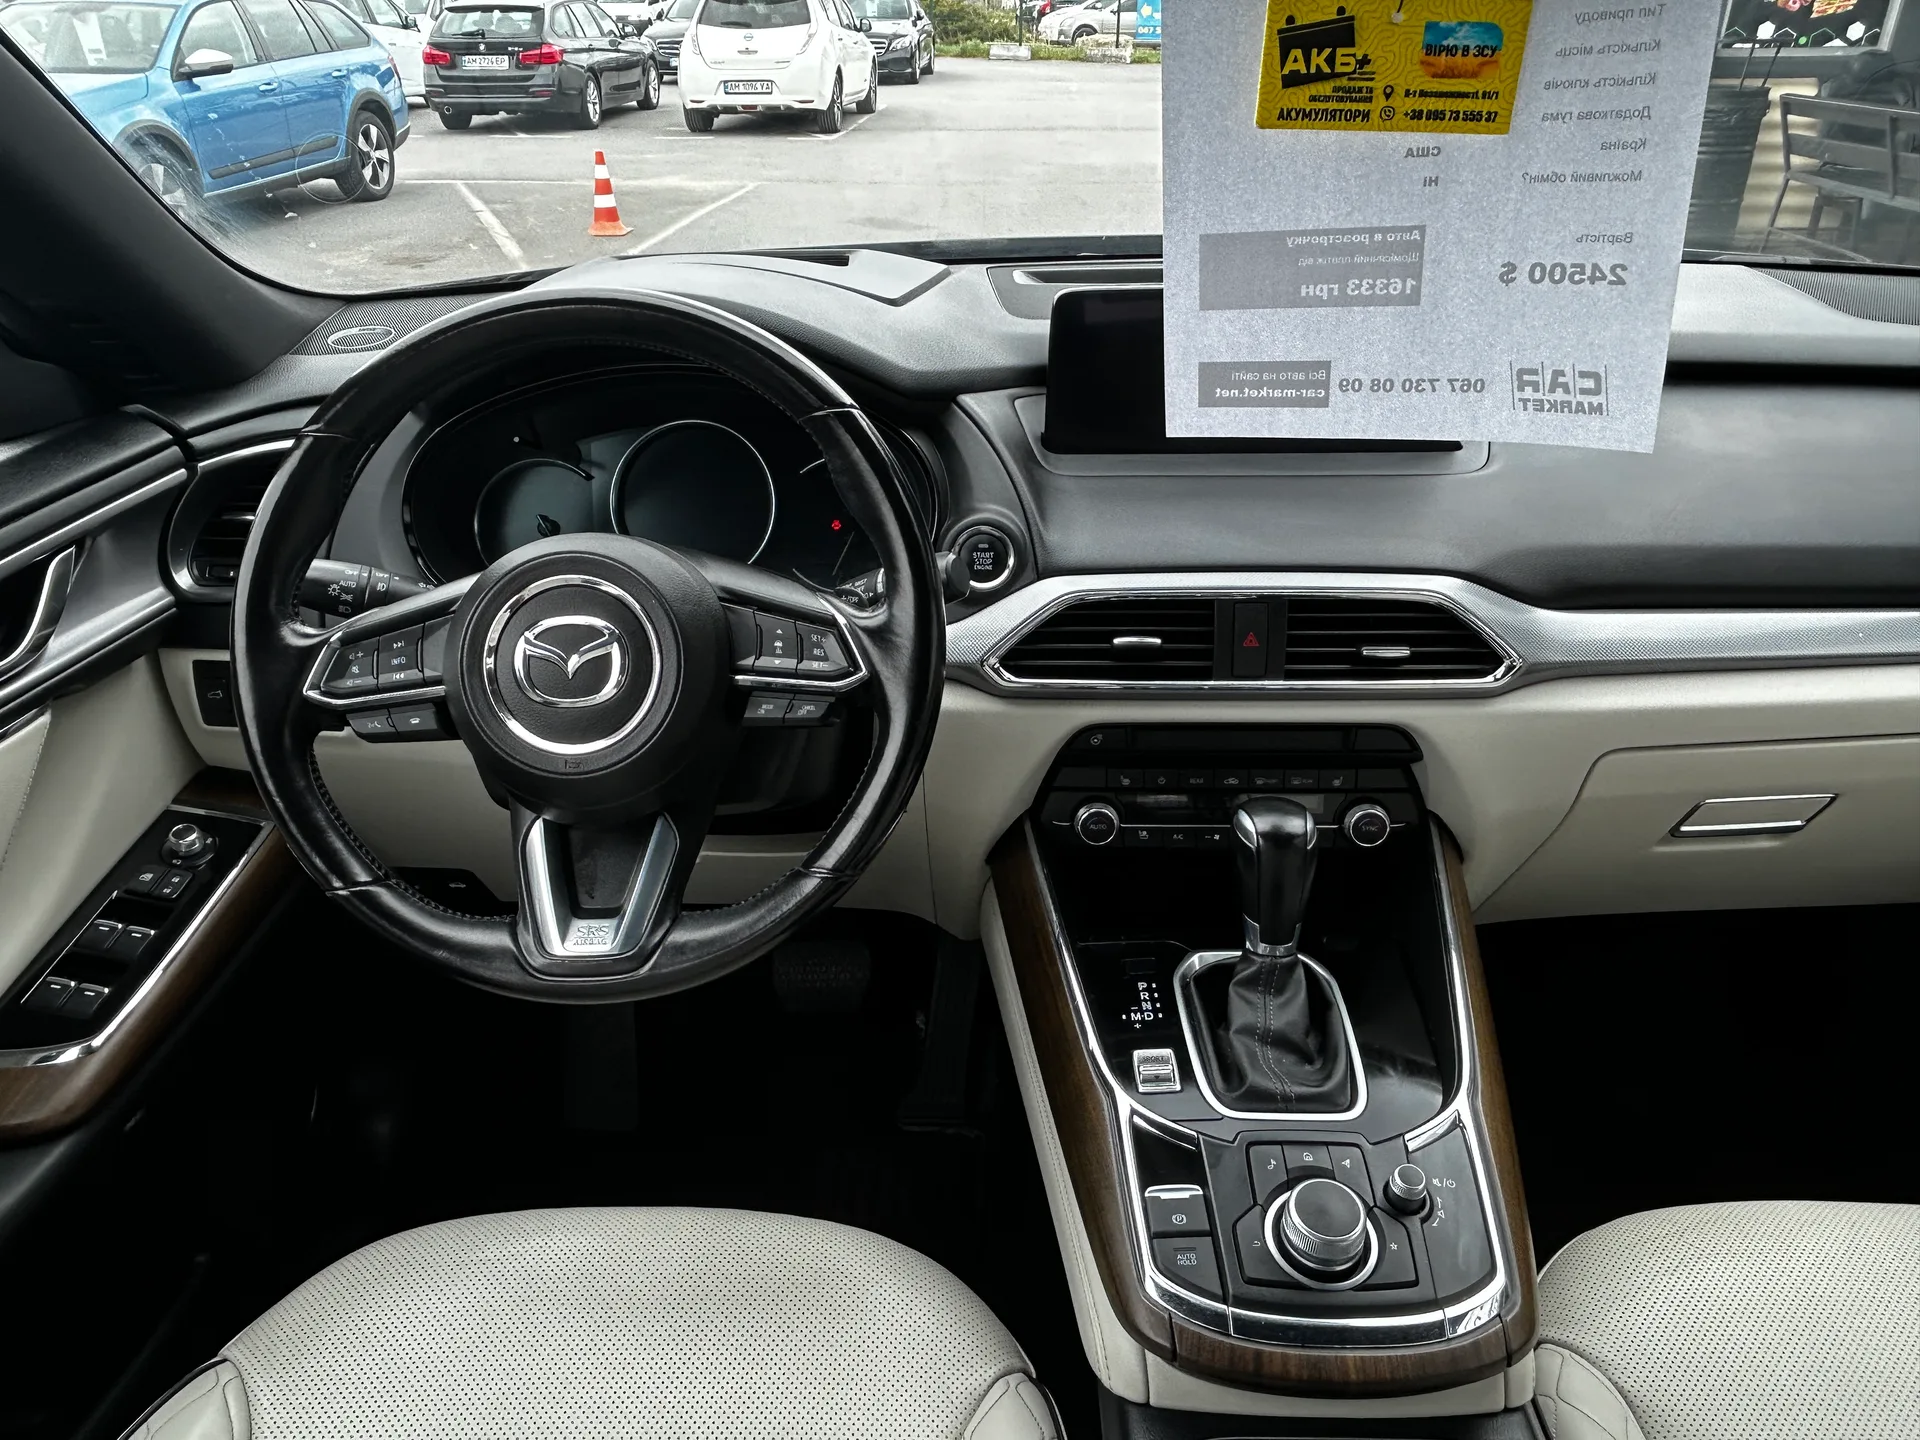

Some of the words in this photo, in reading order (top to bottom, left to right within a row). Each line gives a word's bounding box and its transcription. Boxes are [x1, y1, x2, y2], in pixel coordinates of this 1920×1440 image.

[1425, 43, 1459, 57] ВІРЮ
[1461, 44, 1470, 57] В
[1472, 44, 1498, 58] ЗСУ
[1277, 107, 1371, 123] АКУМУЛЯТОРИ
[1403, 109, 1424, 121] +38
[1425, 109, 1447, 122] 095
[339, 580, 357, 588] AUTO
[391, 656, 406, 666] INFO
[1137, 982, 1147, 990] P
[1140, 992, 1150, 1000] R
[1141, 1001, 1152, 1010] N
